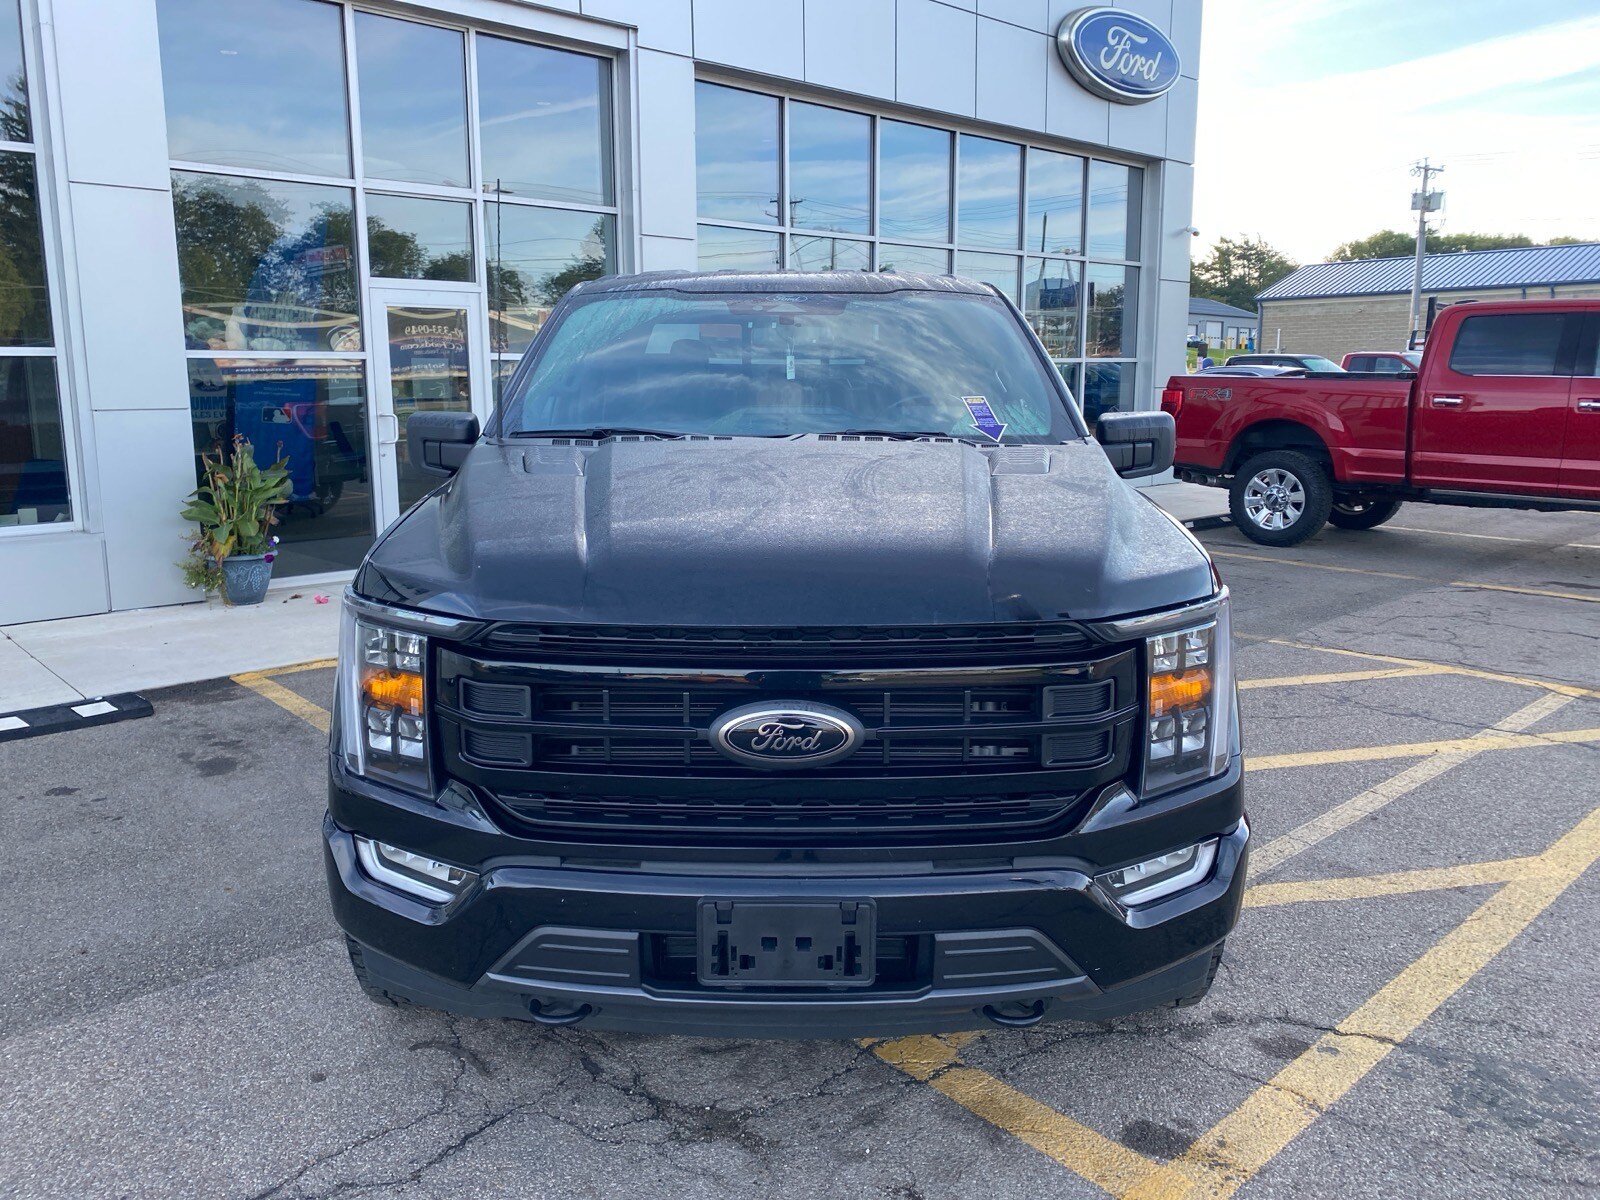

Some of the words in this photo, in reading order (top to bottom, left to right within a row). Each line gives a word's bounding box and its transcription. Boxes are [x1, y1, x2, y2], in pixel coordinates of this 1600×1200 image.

[1100, 25, 1162, 82] Ford
[1189, 387, 1232, 401] FX4
[751, 722, 822, 751] Ford
